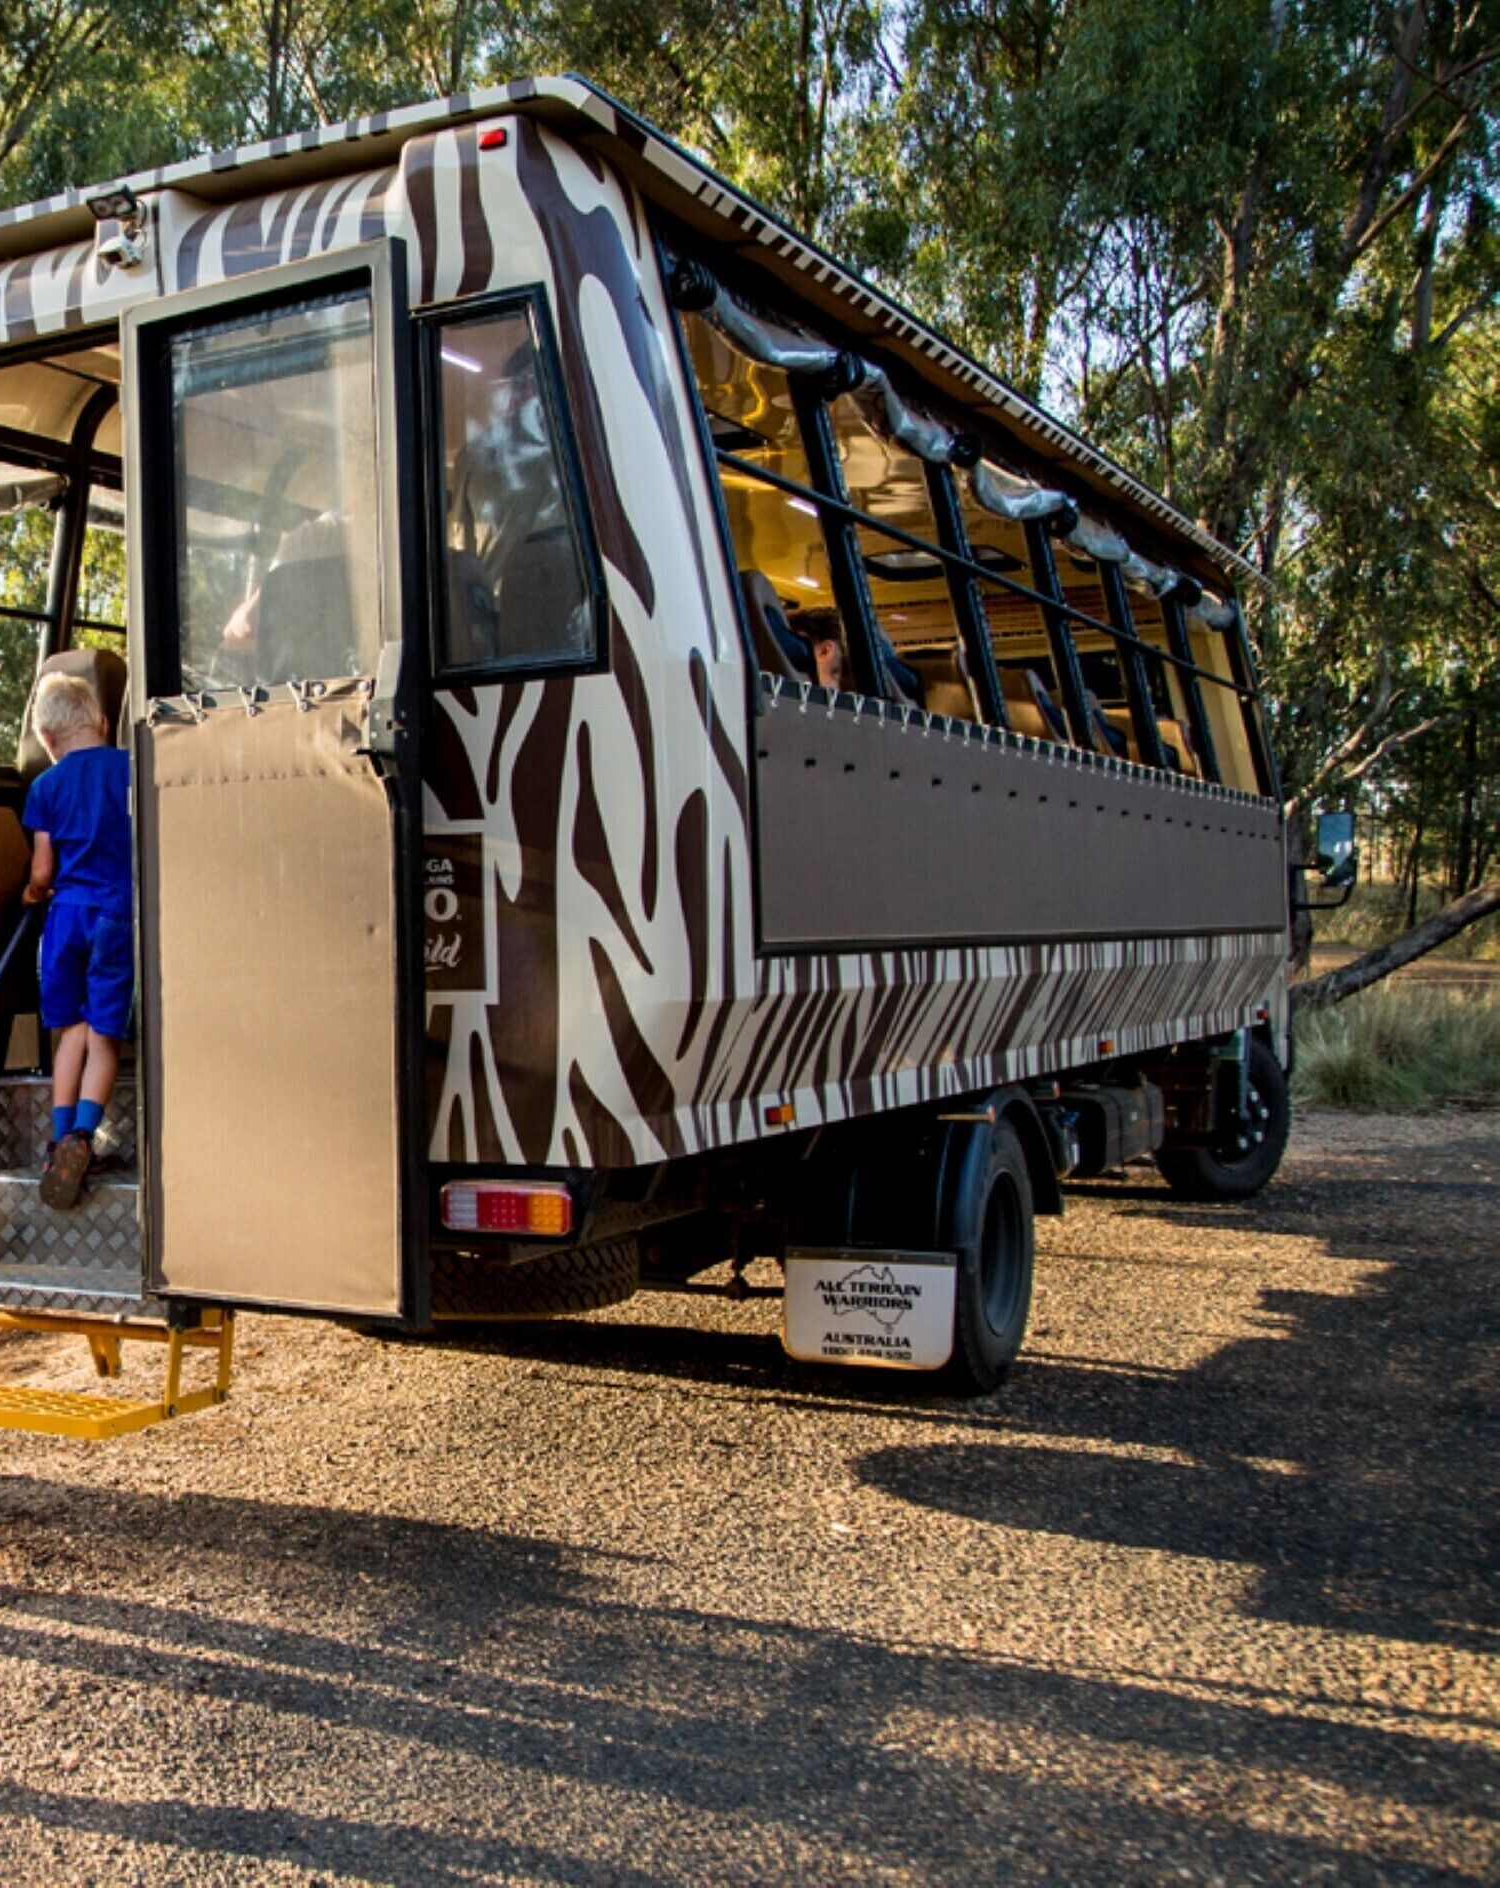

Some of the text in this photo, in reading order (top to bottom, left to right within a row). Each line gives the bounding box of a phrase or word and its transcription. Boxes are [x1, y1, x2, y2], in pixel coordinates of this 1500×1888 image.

[814, 1279, 922, 1297] ALL TERRAIN
[821, 1293, 913, 1310] WARRIORS
[821, 1332, 912, 1348] AUSTRALIA
